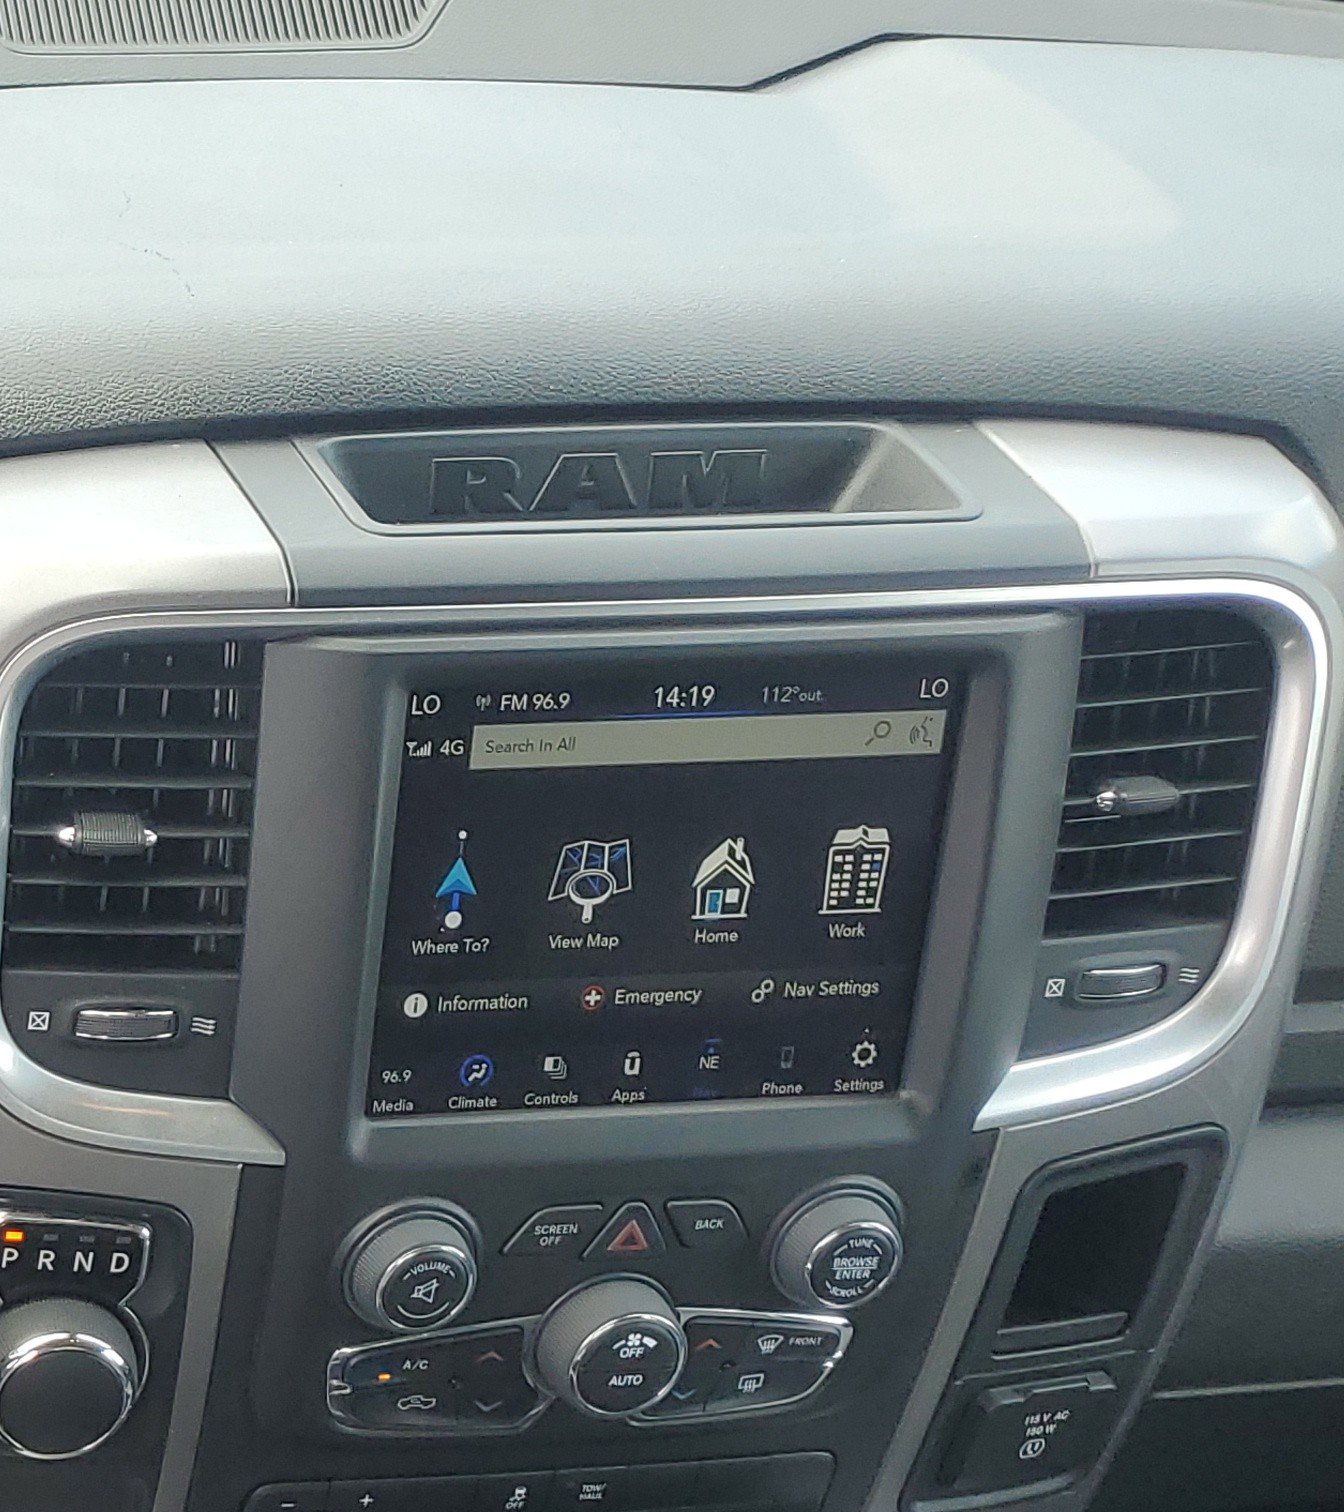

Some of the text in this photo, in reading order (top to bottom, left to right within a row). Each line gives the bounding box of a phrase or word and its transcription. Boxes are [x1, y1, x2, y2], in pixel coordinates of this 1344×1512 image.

[430, 448, 767, 514] RAM
[920, 678, 949, 698] LO
[500, 692, 571, 711] FM 96.9
[655, 686, 715, 708] 14:19
[411, 694, 441, 715] LO
[440, 740, 465, 756] 4G
[485, 736, 576, 754] Search In All
[694, 928, 739, 944] Home
[828, 923, 866, 938] Work
[412, 938, 490, 956] Where To?
[548, 932, 619, 950] View Map
[783, 980, 880, 998] Nav Settings
[437, 994, 528, 1012] Information
[614, 988, 702, 1006] Emergency
[699, 1056, 720, 1070] NE
[382, 1070, 411, 1084] 96.9
[761, 1082, 803, 1094] Phone
[834, 1079, 884, 1093] Settings
[448, 1096, 498, 1109] Climate
[524, 1091, 578, 1106] Controls
[612, 1089, 645, 1102] Apps
[372, 1098, 414, 1112] Media
[534, 1224, 578, 1236] SCREEN
[694, 1218, 724, 1230] BACK
[540, 1236, 562, 1246] OFF
[848, 1238, 874, 1249] TUNE
[1, 1248, 130, 1274] P R N D
[833, 1257, 880, 1268] BROWSE
[410, 1262, 451, 1276] VOLUME
[835, 1270, 871, 1280] ENTER
[830, 1286, 864, 1298] SCROLL
[788, 1336, 822, 1347] FRONT
[619, 1348, 644, 1358] OFF
[402, 1359, 430, 1371] A/C
[608, 1374, 643, 1387] AUTO
[1042, 1412, 1052, 1422] V
[581, 1484, 606, 1492] TOW/
[506, 1502, 525, 1510] OFF
